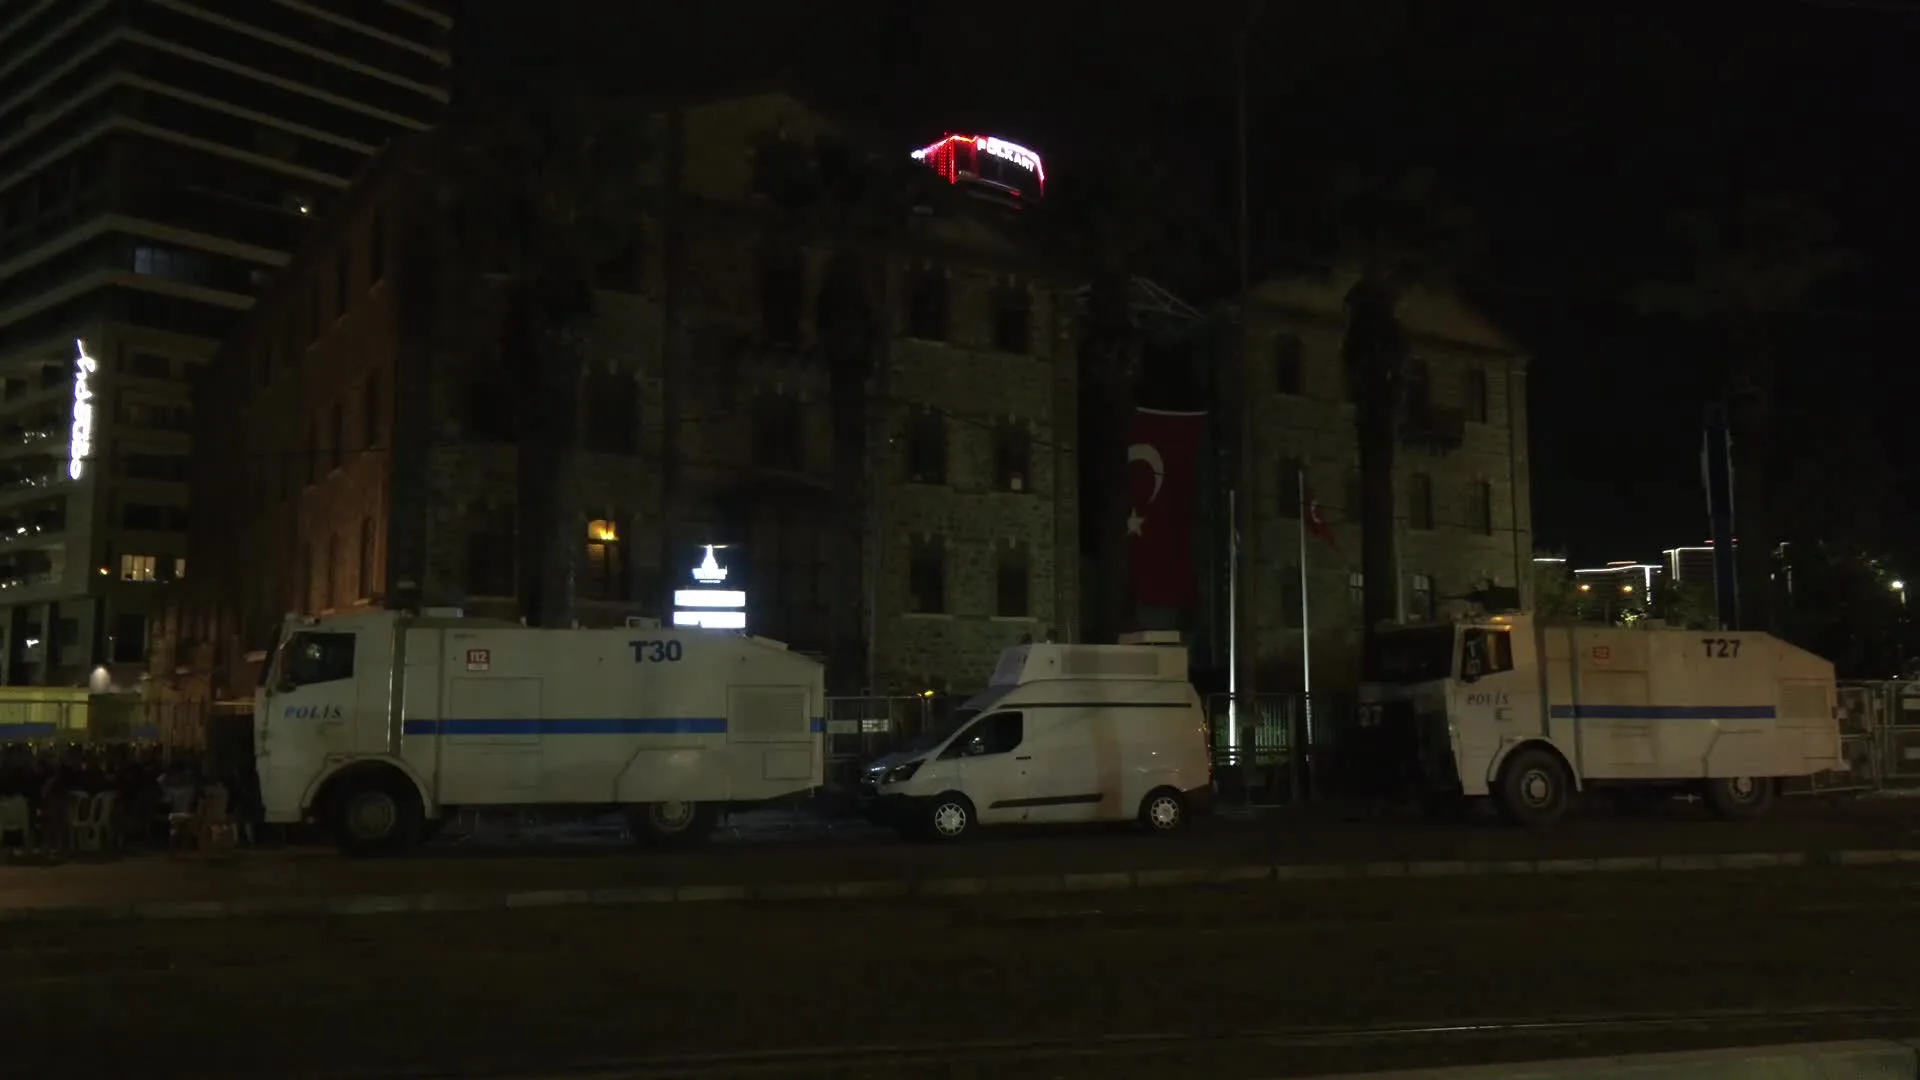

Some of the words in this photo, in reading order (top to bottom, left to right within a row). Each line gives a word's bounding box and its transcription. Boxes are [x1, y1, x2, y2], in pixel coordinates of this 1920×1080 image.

[470, 651, 488, 663] 112
[629, 640, 682, 663] T30
[1702, 639, 1741, 658] T27
